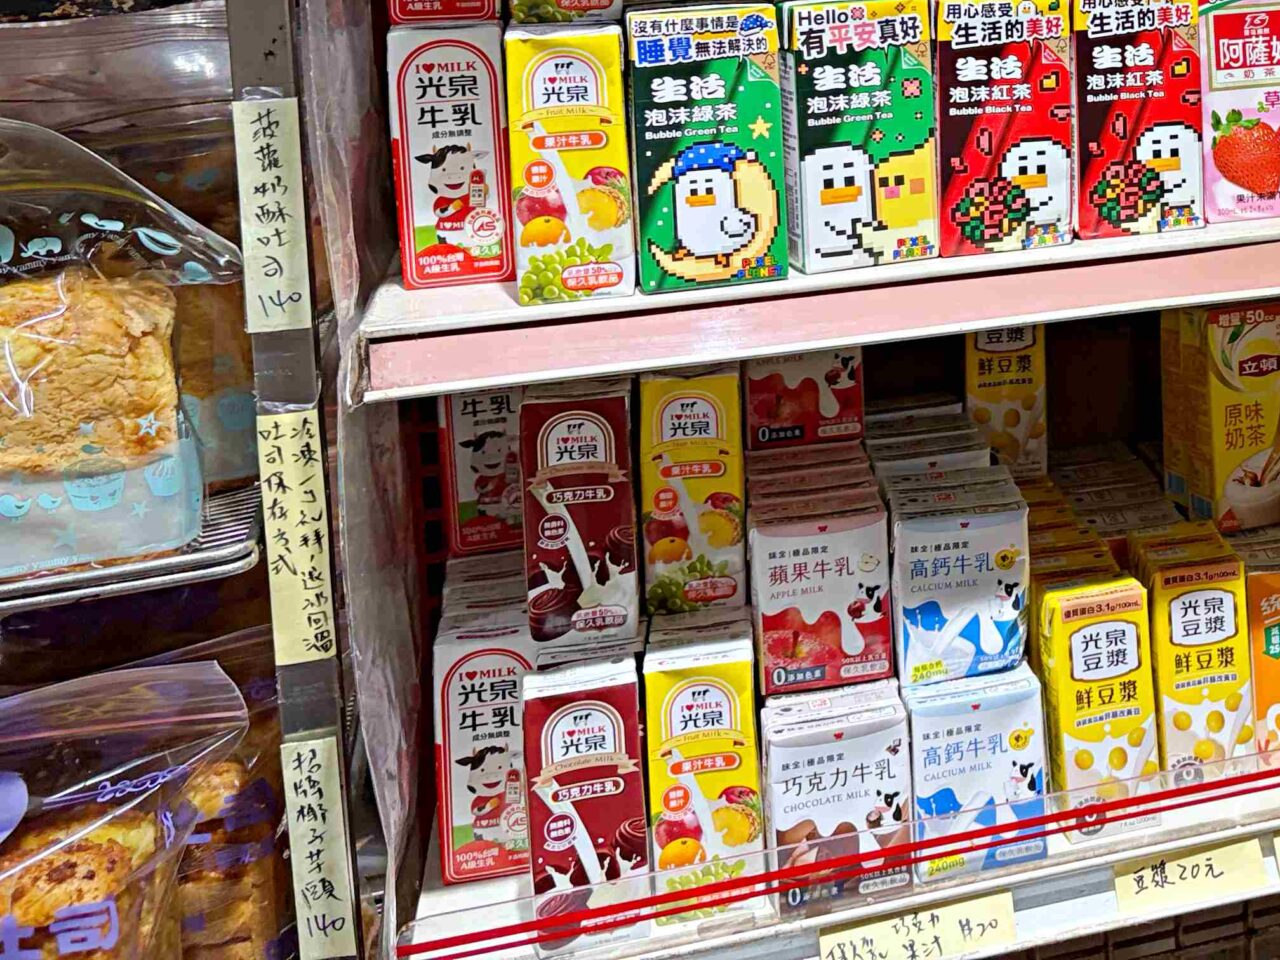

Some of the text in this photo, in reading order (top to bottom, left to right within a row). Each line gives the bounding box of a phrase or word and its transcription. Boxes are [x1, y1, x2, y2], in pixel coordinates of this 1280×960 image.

[798, 10, 849, 27] Hello
[946, 1, 1013, 18] 用心感受
[1089, 5, 1191, 34] 生活的美好
[633, 17, 739, 34] 沒有什麼事情是
[800, 16, 920, 57] 有平安真好
[954, 16, 1062, 46] 生活的美好
[637, 37, 768, 64] 睡覺無法解決的
[1091, 44, 1155, 70] 生活
[812, 63, 881, 91] 生活
[955, 56, 1024, 82] 生活
[1087, 70, 1163, 89] 泡沫紅茶
[415, 76, 480, 99] 光泉
[542, 86, 589, 104] 光泉
[651, 73, 726, 103] 生活
[949, 84, 1032, 102] 泡沫紅茶
[1087, 90, 1165, 102] Bubble Black Tea
[807, 90, 892, 114] 泡沫綠茶
[950, 104, 1032, 116] Bubble Black Tea
[417, 104, 482, 128] 牛乳
[645, 103, 737, 127] 泡沫綠茶
[808, 111, 893, 127] Bubble Green Tea
[432, 130, 472, 140] 成分無調整
[544, 136, 592, 146] 果汁牛乳
[645, 125, 739, 140] Bubble Green Tea
[893, 245, 935, 259] PLANET
[897, 236, 930, 247] PIXEL
[737, 265, 783, 279] PLANET
[742, 256, 777, 268] PIXEL
[258, 290, 302, 318] 140
[1241, 357, 1279, 375] 立頓
[1224, 402, 1264, 427] 原味
[259, 422, 298, 576] 吐司保存方式
[552, 488, 607, 502] 巧克力牛乳
[768, 556, 854, 586] 蘋果牛乳
[910, 552, 995, 580] 高鈣牛乳
[770, 585, 823, 600] APPLE MILK
[911, 579, 979, 593] CALCIUM MILK
[1180, 616, 1226, 638] 豆漿
[1082, 649, 1128, 672] 豆漿
[1174, 647, 1235, 674] 鮮豆漿
[694, 702, 723, 711] MILK
[1075, 681, 1139, 711] 鮮豆漿
[459, 708, 520, 731] 牛乳
[577, 725, 606, 736] MILK
[922, 734, 1008, 768] 高鈣牛乳
[682, 758, 726, 771] 果汁牛乳
[924, 761, 992, 782] CALCIUM MILK
[782, 758, 897, 797] 巧克力牛乳
[557, 781, 616, 801] 巧克力牛乳
[784, 789, 871, 814] CHOCOLATE MILK
[306, 913, 345, 938] 140
